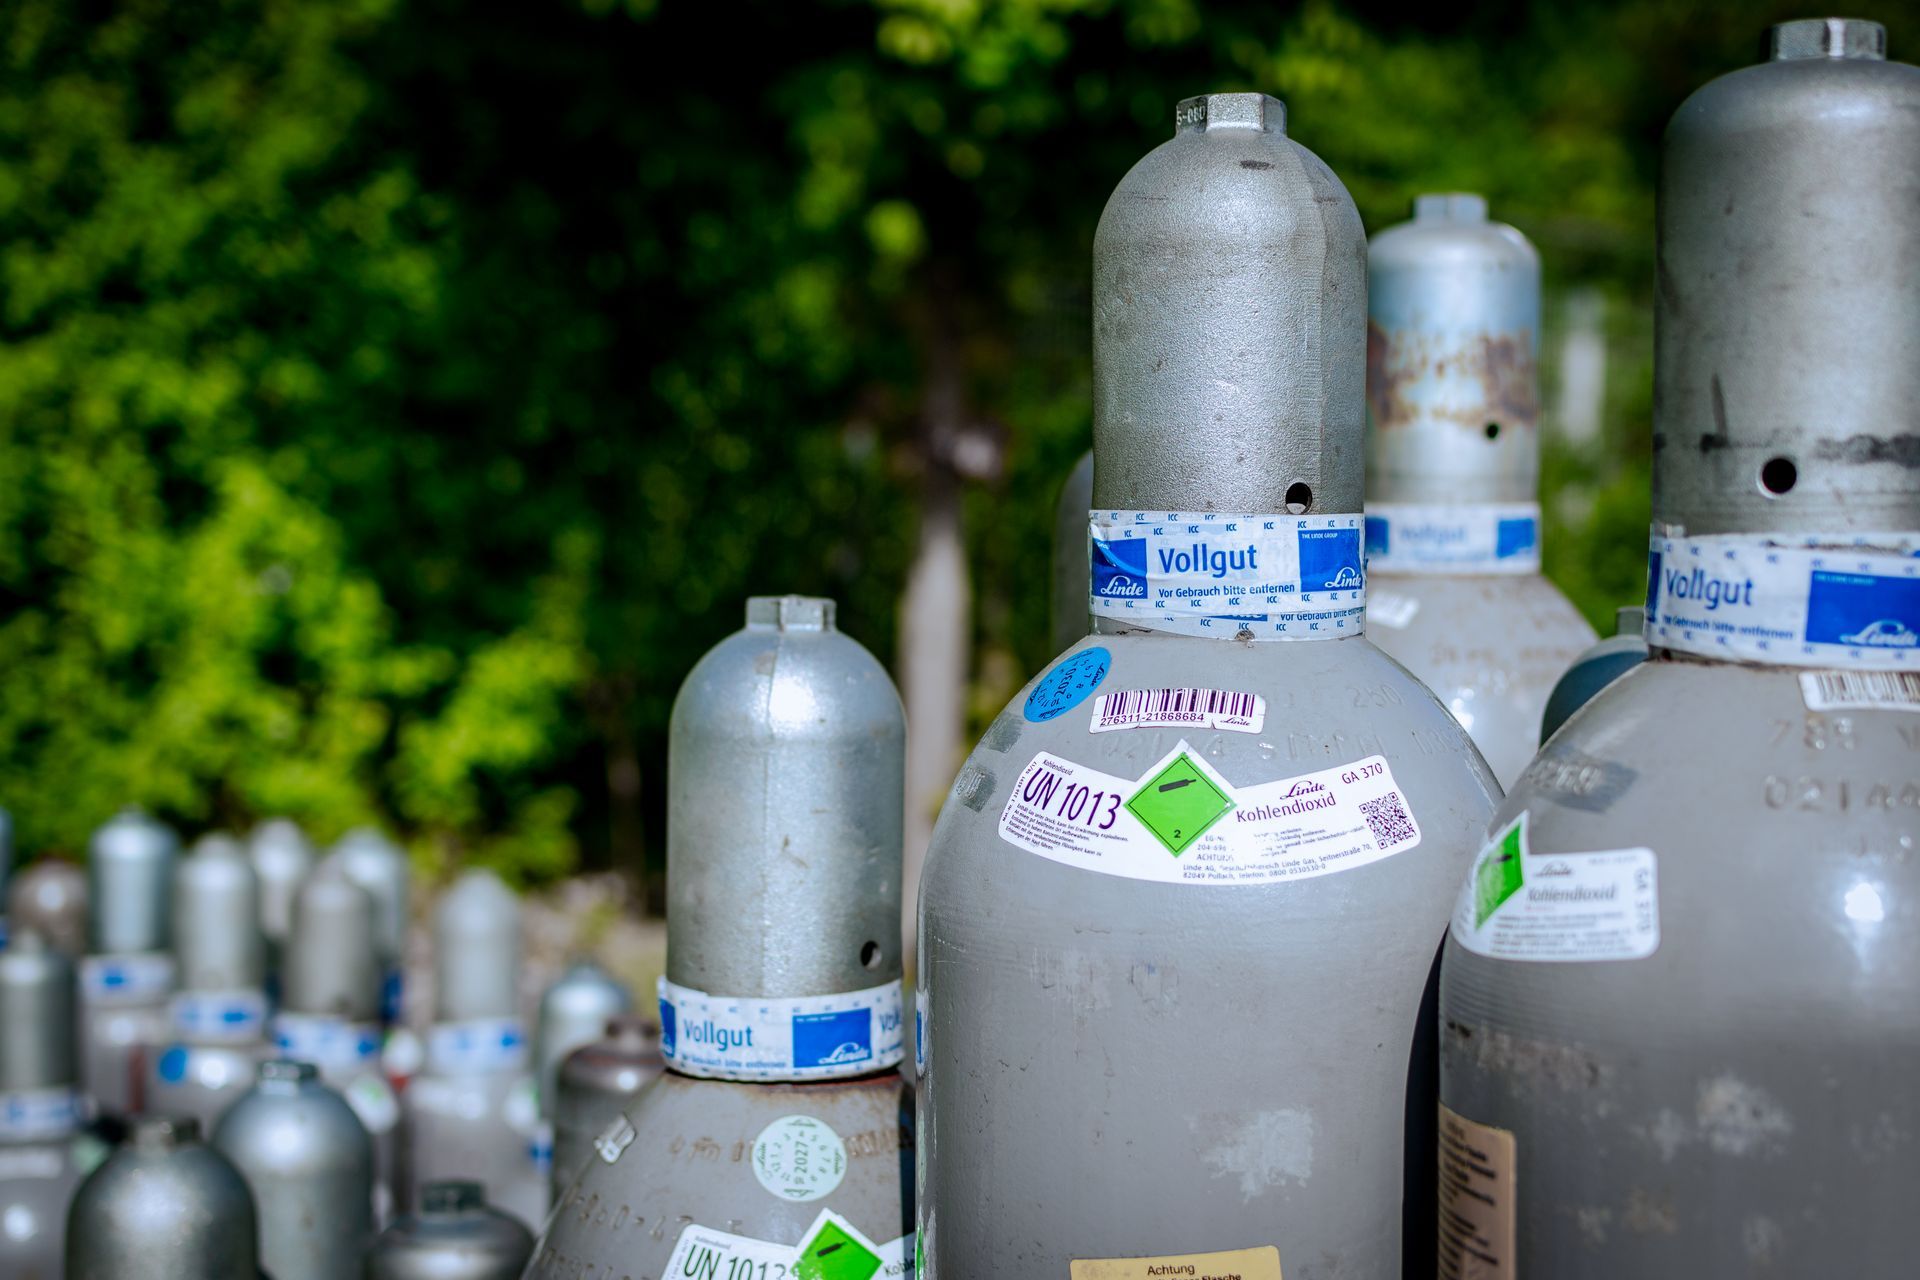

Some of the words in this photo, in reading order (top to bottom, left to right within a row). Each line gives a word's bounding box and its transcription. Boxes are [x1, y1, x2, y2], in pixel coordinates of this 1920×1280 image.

[1167, 513, 1178, 521] ICC
[1153, 527, 1163, 536] ICC
[1188, 525, 1199, 534] ICC
[1225, 523, 1237, 532] ICC
[1263, 521, 1274, 530] ICC
[1297, 520, 1307, 529] ICC
[1158, 543, 1258, 579] Vollgut
[1100, 575, 1144, 596] Linde
[1158, 588, 1173, 598] Vor
[1176, 586, 1220, 597] Gebrauch
[1223, 585, 1246, 596] bitte
[1249, 583, 1295, 594] entfernen
[1665, 567, 1754, 611] Vollgut
[1125, 600, 1134, 608] ICC
[1155, 600, 1165, 608] ICC
[1190, 599, 1202, 607] ICC
[1229, 597, 1240, 606] ICC
[1266, 596, 1277, 604] ICC
[1301, 594, 1310, 602] ICC
[1200, 618, 1212, 627] ICC
[1238, 622, 1250, 631] ICC
[1276, 623, 1287, 631] ICC
[1310, 622, 1319, 631] ICC
[1100, 712, 1205, 727] 276311-21868684
[1219, 716, 1251, 727] Linde
[1341, 770, 1360, 785] GA
[1360, 762, 1384, 779] 370
[1023, 767, 1063, 811] UN
[1057, 782, 1122, 830] 1013
[1279, 779, 1326, 801] Linde
[1236, 791, 1337, 823] Kohlendioxid
[1174, 829, 1181, 839] 2
[682, 1017, 754, 1052] Vollgut
[794, 1140, 809, 1174] 2027
[683, 1243, 722, 1280] UN
[1147, 1264, 1196, 1276] Achtung
